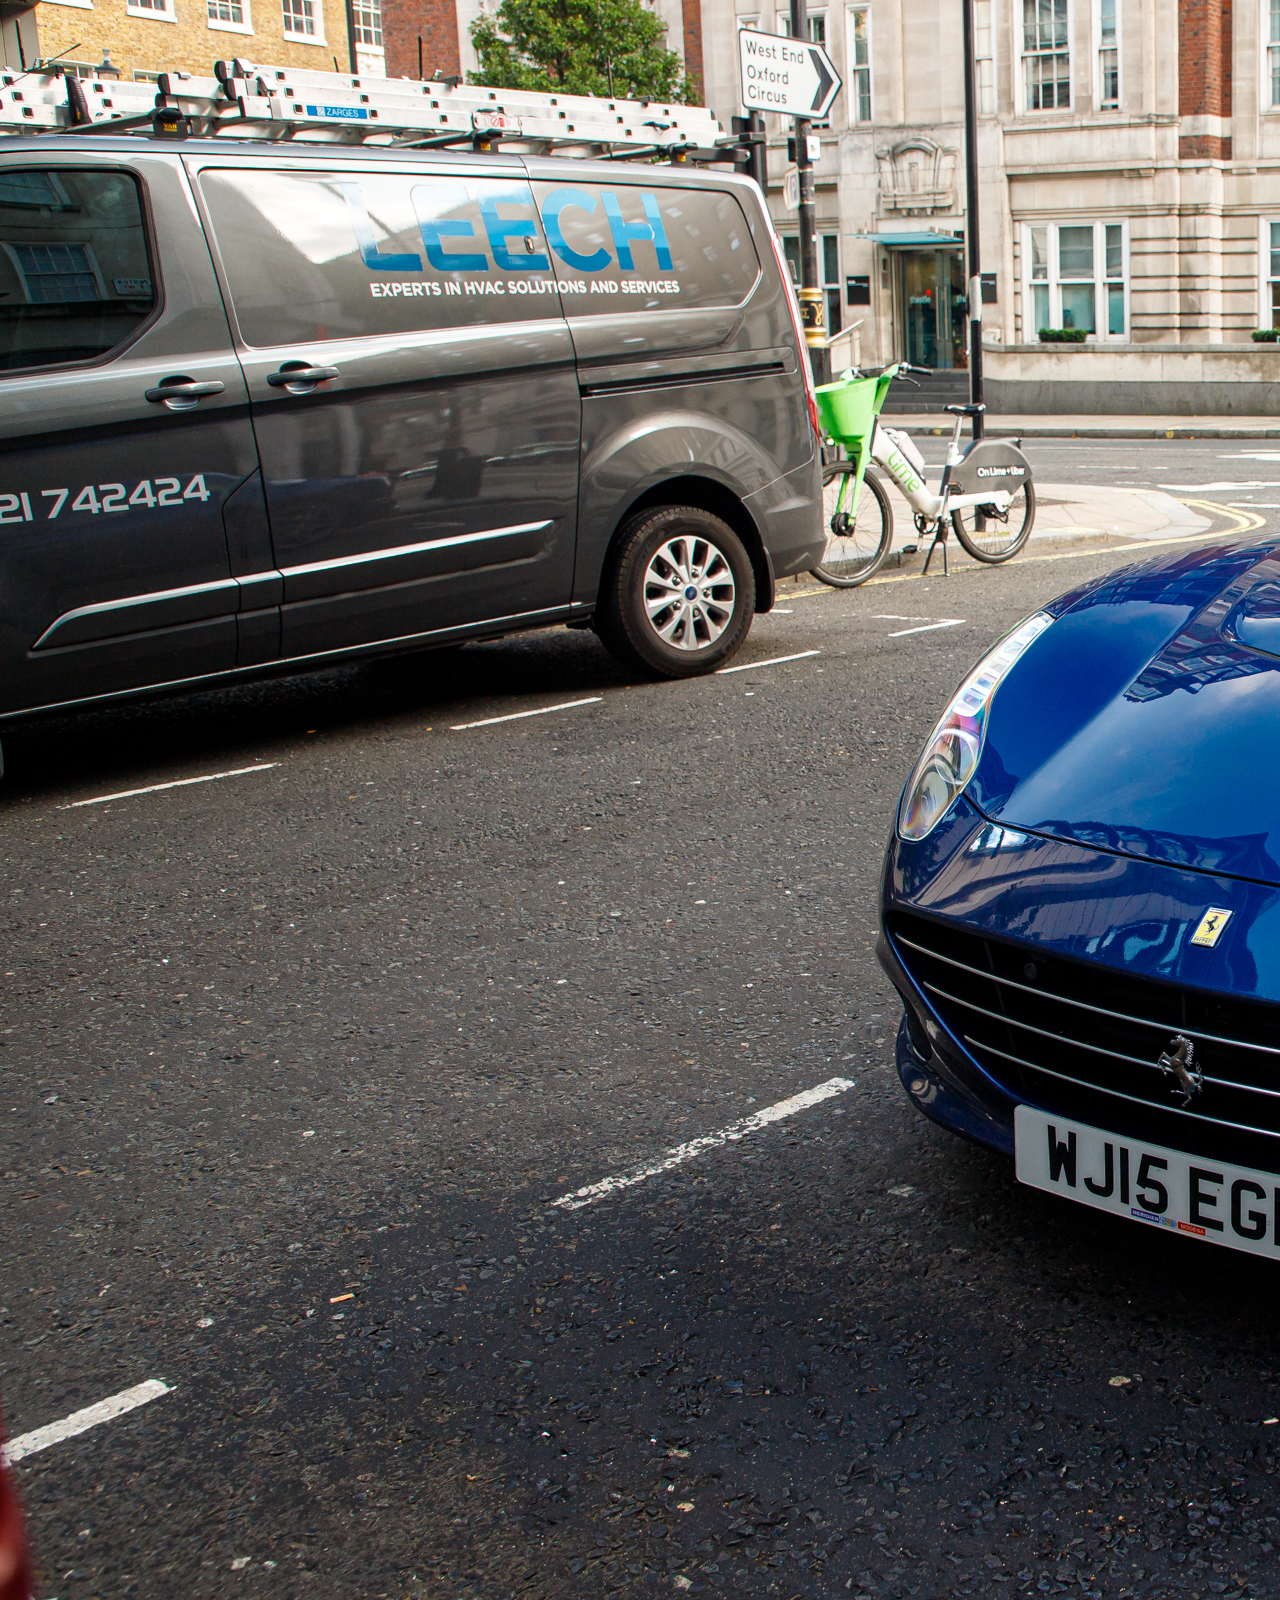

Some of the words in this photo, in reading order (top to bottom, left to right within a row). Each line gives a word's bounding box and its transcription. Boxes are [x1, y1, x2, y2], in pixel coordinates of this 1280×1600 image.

[745, 40, 777, 60] West
[781, 47, 804, 64] End
[747, 64, 789, 85] Oxford
[748, 84, 787, 104] Circus
[326, 107, 359, 118] ZARGES
[340, 182, 674, 272] LEECH
[370, 281, 442, 298] EXPERTS
[445, 281, 462, 296] IN
[464, 281, 506, 296] HVAC
[507, 280, 589, 295] SOLUTIONS
[590, 280, 619, 294] AND
[621, 280, 681, 294] SERVICES
[887, 450, 920, 493] Lime
[977, 467, 990, 477] On
[990, 466, 1007, 477] Lime
[1011, 466, 1026, 477] Uber
[0, 492, 34, 525] 21
[41, 474, 211, 519] 742424
[1047, 1124, 1168, 1214] WJ15
[1132, 1209, 1160, 1222] MERIDIEN
[1180, 1223, 1205, 1235] MODENA
